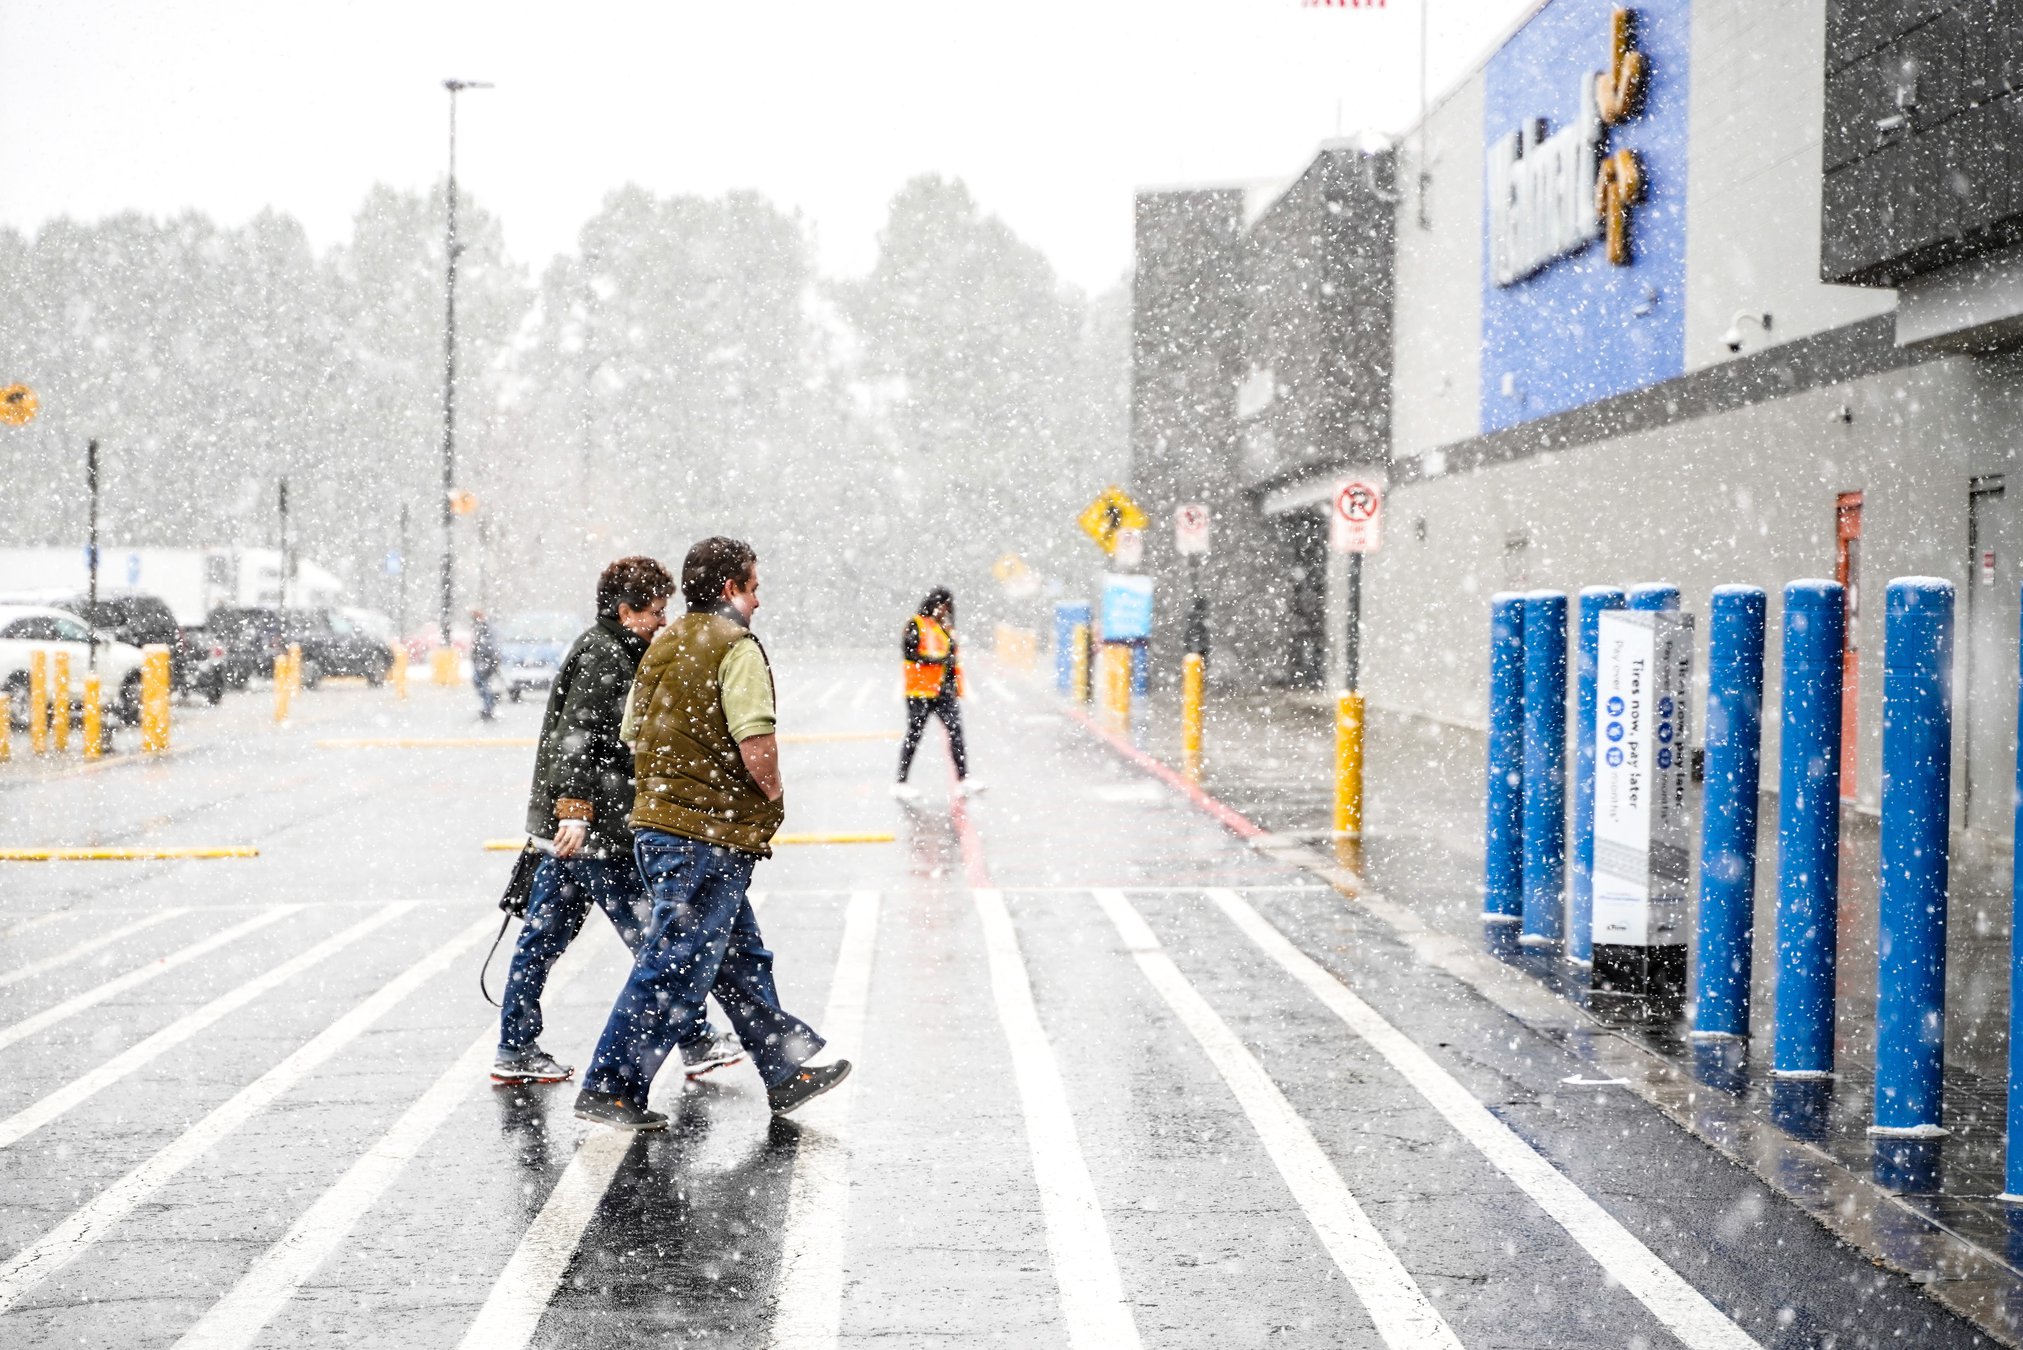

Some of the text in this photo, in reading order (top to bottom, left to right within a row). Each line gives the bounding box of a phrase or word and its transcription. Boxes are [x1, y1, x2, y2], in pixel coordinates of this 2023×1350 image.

[1627, 659, 1644, 809] Tires now, pay later
[1674, 742, 1684, 768] pay
